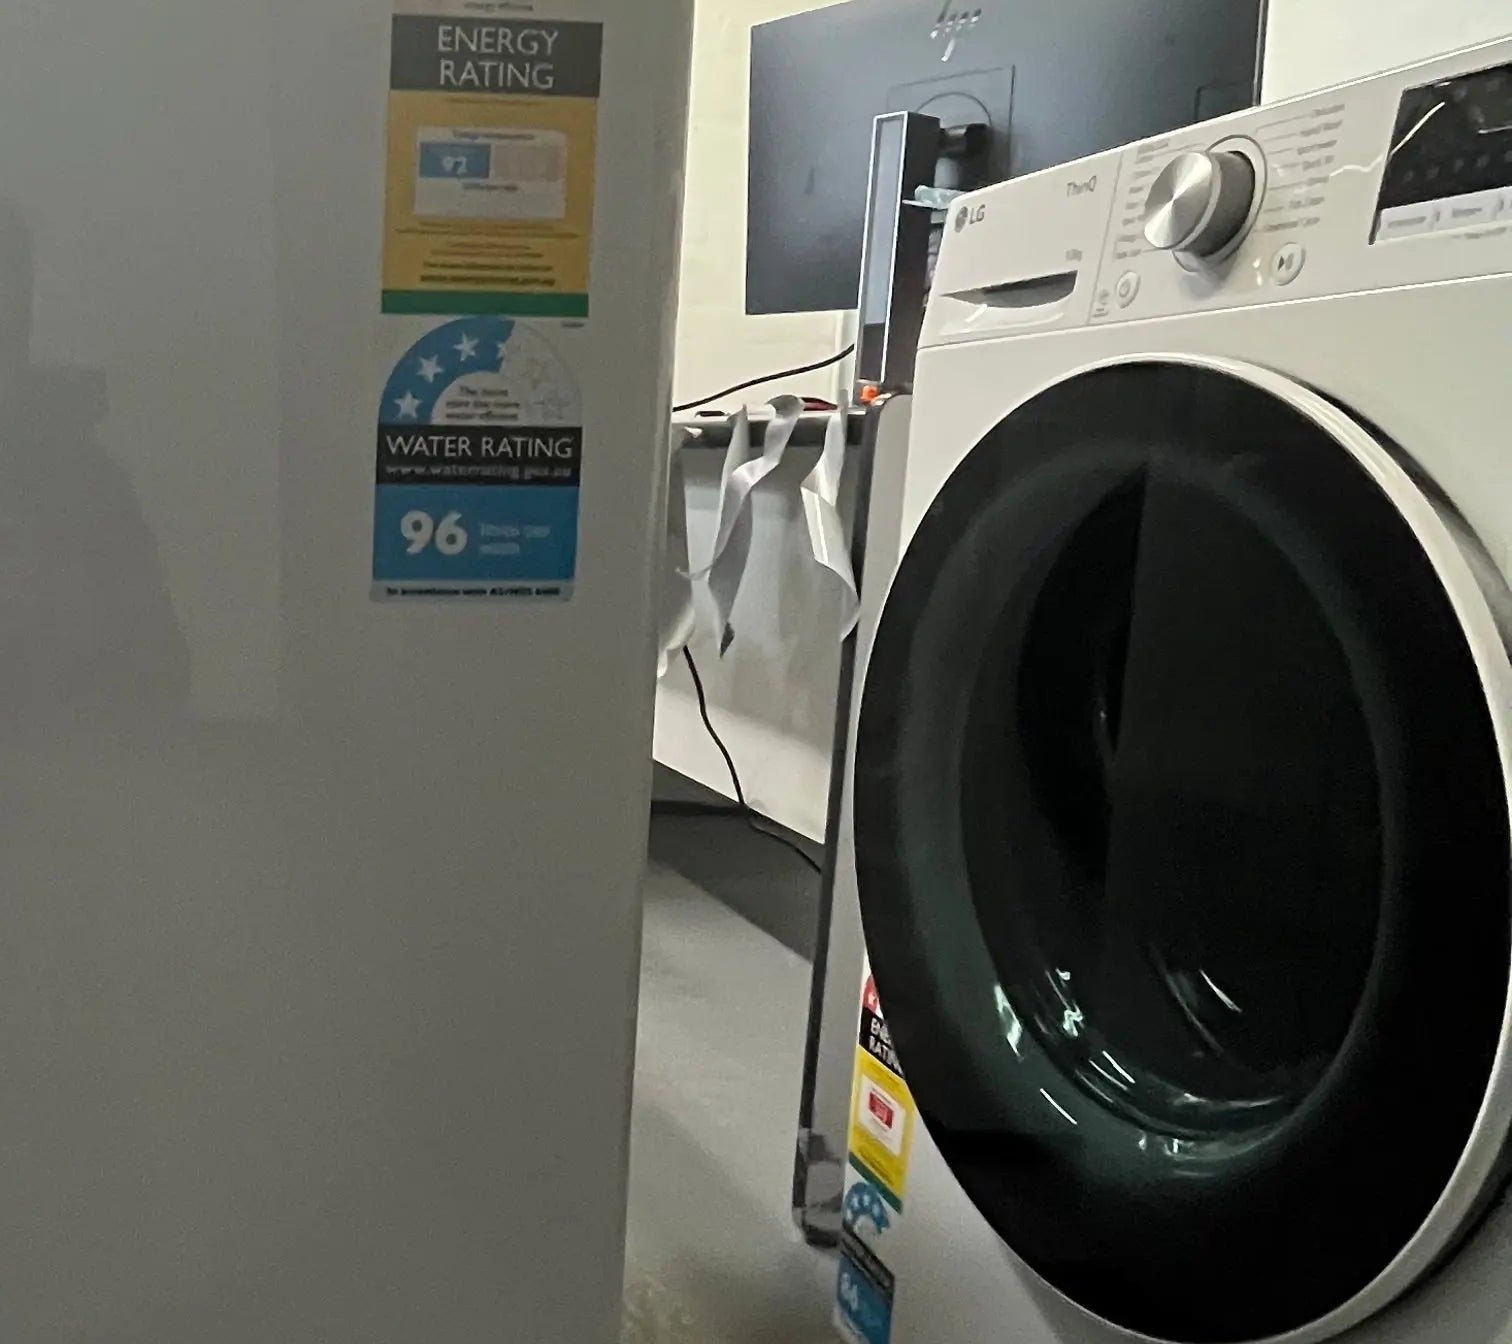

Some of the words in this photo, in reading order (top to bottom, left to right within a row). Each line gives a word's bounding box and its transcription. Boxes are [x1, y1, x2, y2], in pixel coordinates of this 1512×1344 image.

[437, 25, 559, 57] ENERGY
[440, 58, 555, 90] RATING
[1066, 175, 1097, 198] ThinQ
[968, 204, 987, 225] LG
[386, 434, 472, 458] WATER
[480, 435, 573, 460] RATING
[400, 509, 469, 556] 96
